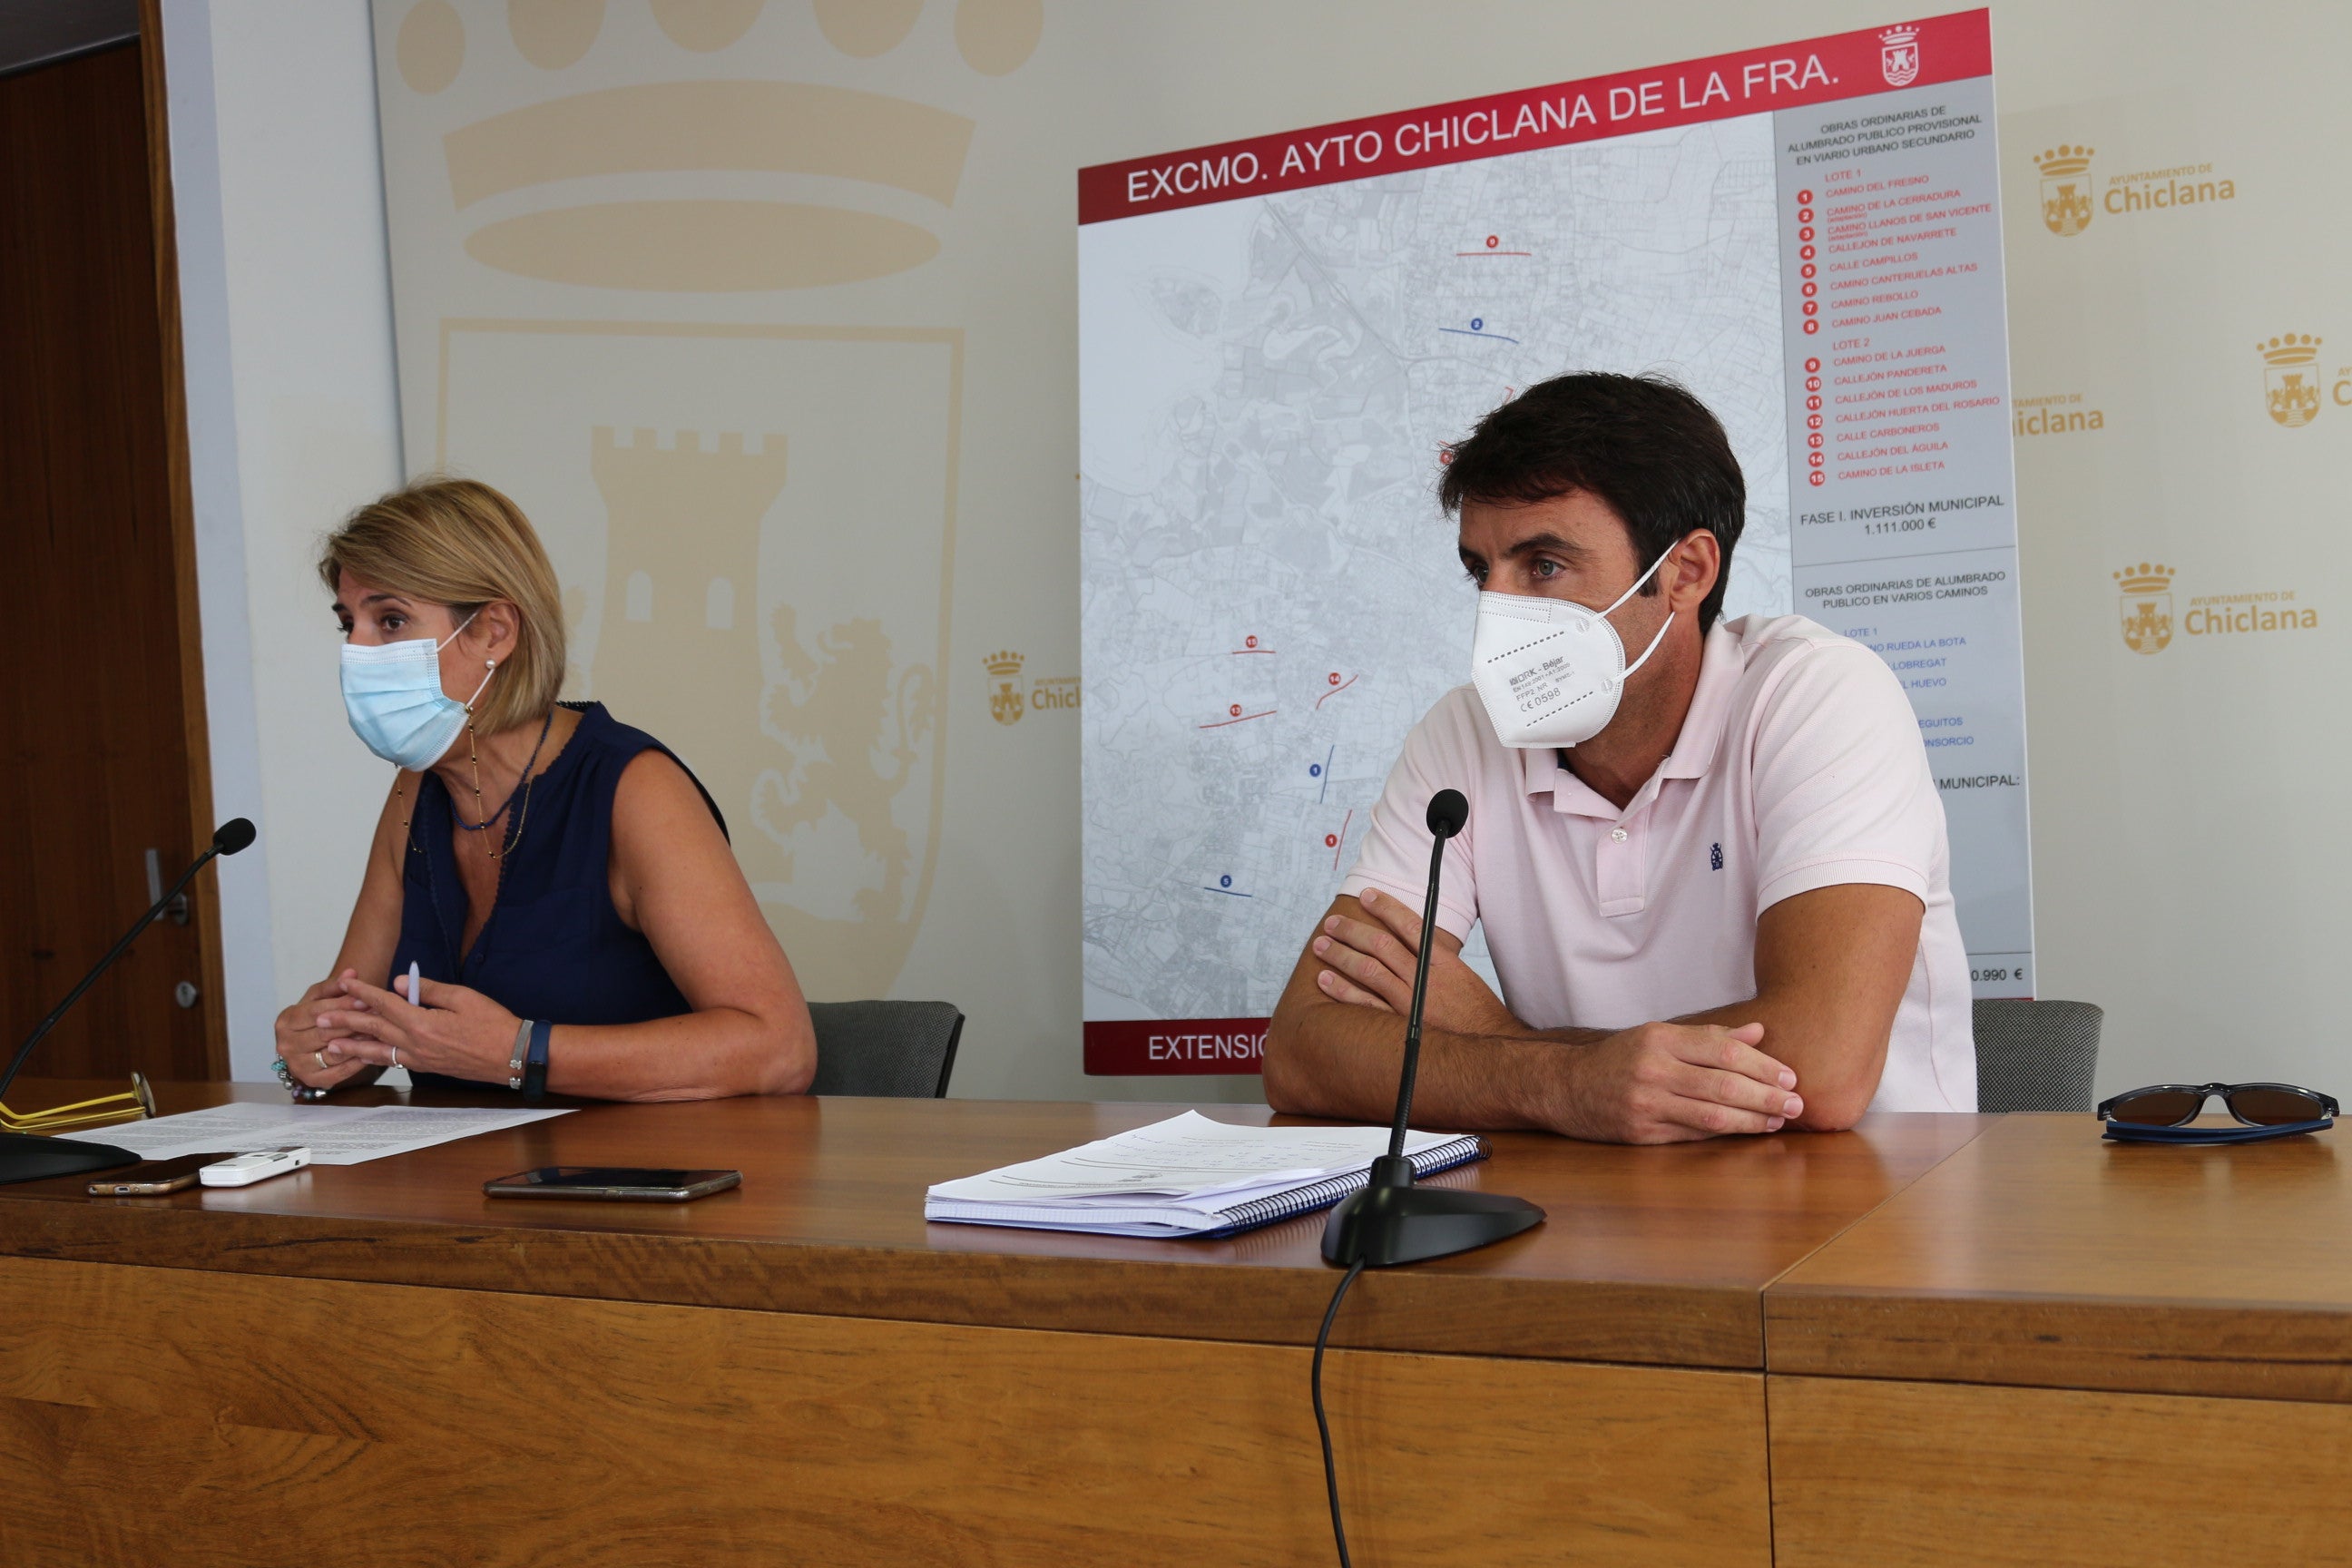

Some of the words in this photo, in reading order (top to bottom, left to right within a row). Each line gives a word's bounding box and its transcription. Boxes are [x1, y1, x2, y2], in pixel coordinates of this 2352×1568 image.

[1125, 150, 1268, 204] EXCMO.
[1279, 129, 1383, 179] AYTO
[1394, 93, 1598, 158] CHICLANA
[1610, 81, 1665, 122] DE
[1679, 71, 1730, 110] LA
[1743, 54, 1839, 99] FRA.
[1821, 119, 1857, 134] OBRAS
[1861, 109, 1927, 127] ORDINARIAS
[1931, 105, 1946, 117] DE
[1788, 133, 1855, 153] ALUMBRADO
[1857, 125, 1905, 142] PUBLICO
[1907, 114, 1983, 134] PROVISIONAL
[1797, 154, 1811, 166] EN
[1815, 149, 1850, 163] VIARIO
[1853, 142, 1899, 157] URBANO
[1901, 128, 1975, 150] SECUNDARIO
[1824, 170, 1853, 183] LOTE
[1857, 168, 1862, 177] 1
[2109, 166, 2196, 186] AYUNTAMIENTO
[2198, 162, 2214, 173] DE
[1826, 185, 1865, 199] CAMINO
[1867, 182, 1885, 193] DEL
[1888, 174, 1930, 190] FRESNO
[2104, 179, 2236, 215] Chiclana
[1827, 204, 1866, 217] CAMINO
[1868, 200, 1882, 211] DE
[1884, 198, 1896, 209] LA
[1898, 189, 1961, 207] CERRADURA
[1828, 221, 1867, 235] CAMINO
[1868, 215, 1906, 230] LLANOS
[1909, 212, 1923, 224] DE
[1926, 210, 1946, 222] SAN
[1948, 202, 1993, 219] VICENTE
[1881, 235, 1894, 247] DE
[1896, 227, 1957, 244] NAVARRETE
[1829, 260, 1859, 272] CALLE
[1863, 252, 1918, 269] CAMPILLOS
[1830, 278, 1869, 291] CAMINO
[1871, 268, 1944, 286] CANTERUELAS
[1945, 262, 1978, 276] ALTAS
[1831, 297, 1869, 309] CAMINO
[1872, 289, 1919, 305] REBOLLO
[1831, 315, 1871, 328] CAMINO
[1873, 311, 1899, 324] JUAN
[1901, 306, 1942, 320] CEBADA
[1833, 338, 1860, 351] LOTE
[1863, 338, 1870, 348] 2
[1834, 353, 1873, 367] CAMINO
[1875, 351, 1888, 362] DE
[1891, 348, 1904, 360] LA
[1906, 344, 1946, 358] JUERGA
[1834, 370, 1885, 386] CALLEJÓN
[1886, 363, 1948, 380] PANDERETA
[1835, 388, 1886, 405] CALLEJÓN
[1888, 387, 1901, 399] DE
[1904, 385, 1925, 397] LOS
[1926, 378, 1977, 395] MADUROS
[2069, 393, 2084, 404] DE
[1836, 407, 1886, 424] CALLEJÓN
[1888, 403, 1930, 417] HUERTA
[1932, 401, 1950, 413] DEL
[1953, 396, 2000, 410] ROSARIO
[1837, 429, 1867, 443] CALLE
[1870, 422, 1940, 439] CARBONEROS
[1838, 446, 1887, 461] CALLEJÓN
[1890, 445, 1909, 456] DEL
[1912, 440, 1948, 454] ÁGUILA
[1838, 467, 1877, 480] CAMINO
[1879, 465, 1893, 476] DE
[1896, 463, 1907, 475] LA
[1910, 460, 1945, 473] ISLETA
[1800, 511, 1835, 526] FASE
[1838, 511, 1847, 523] I.
[1850, 501, 1925, 521] INVERSIÓN
[1928, 495, 2004, 513] MUNICIPAL
[1865, 518, 1925, 535] 1.111.000
[1927, 516, 1936, 529] €
[1805, 584, 1843, 599] OBRAS
[1846, 578, 1914, 595] ORDINARIAS
[1916, 576, 1932, 588] DE
[1935, 571, 2006, 587] ALUMBRADO
[1822, 595, 1871, 610] PUBLICO
[1873, 593, 1888, 605] EN
[1891, 590, 1934, 604] VARIOS
[1936, 585, 1989, 600] CAMINOS
[2190, 592, 2278, 607] AYUNTAMIENTO
[2281, 591, 2296, 602] DE
[2184, 604, 2318, 636] Chiclana
[1844, 627, 1870, 639] LOTE
[1886, 640, 1922, 652] RUEDA
[1924, 639, 1936, 649] LA
[1939, 637, 1967, 648] BOTA
[1911, 677, 1947, 689] HUEVO
[1031, 685, 1081, 710] Chicl
[1515, 689, 1536, 702] FFP2
[1534, 687, 1562, 707] 0598
[1918, 716, 1964, 729] EGUITOS
[1923, 736, 1975, 748] NSORCIO
[1939, 774, 2021, 790] MUNICIPAL:
[1971, 968, 2007, 982] 0.990
[2014, 967, 2024, 981] €
